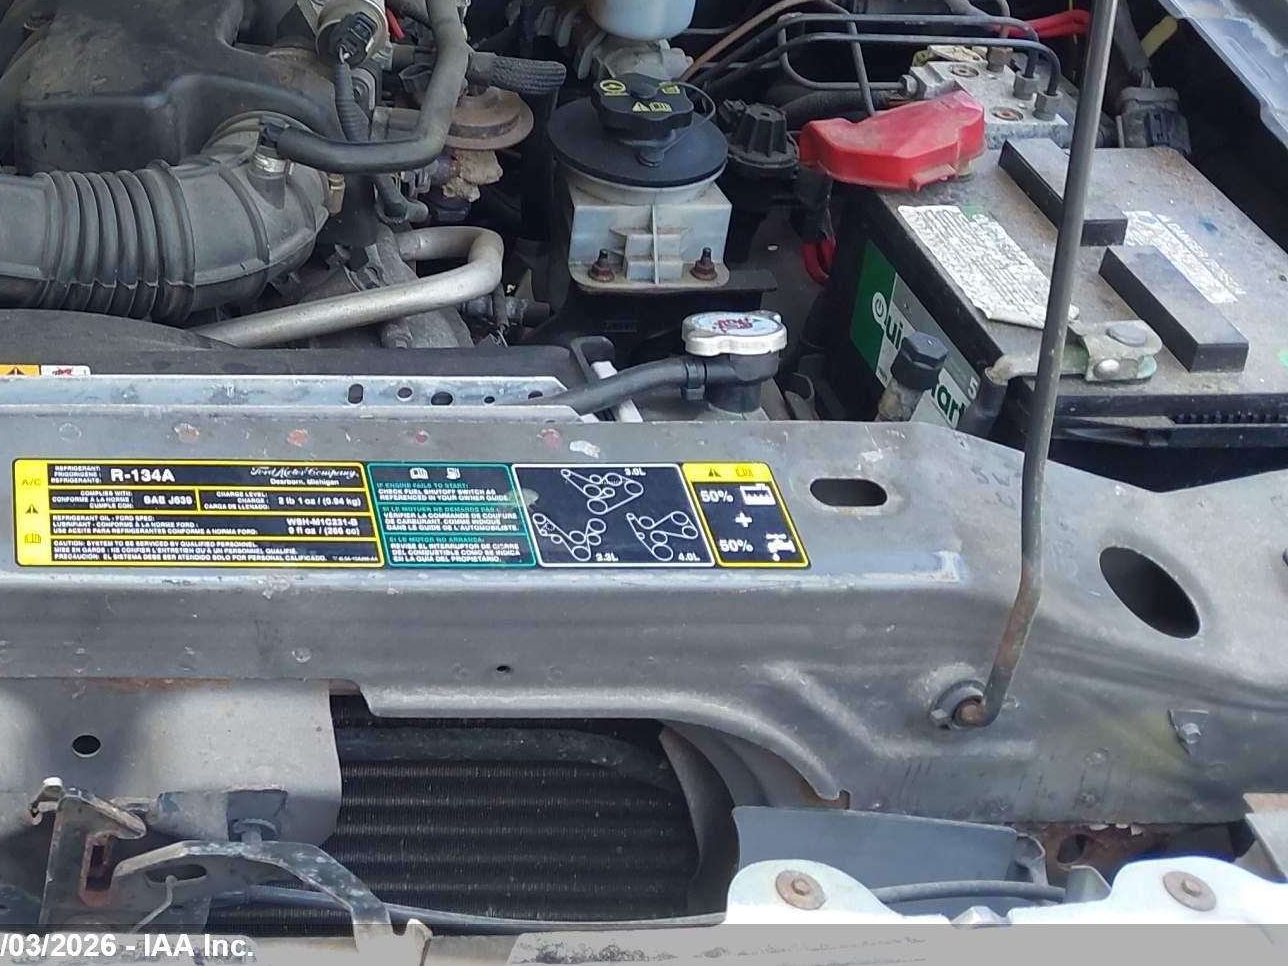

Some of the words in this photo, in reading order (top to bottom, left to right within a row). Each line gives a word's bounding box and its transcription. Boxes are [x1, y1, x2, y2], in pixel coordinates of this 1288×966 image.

[110, 468, 176, 484] R-134A
[624, 467, 646, 476] 3.0L
[22, 478, 41, 486] A/C
[700, 489, 733, 503] 50%
[719, 539, 753, 553] 50%
[678, 553, 700, 562] 4.0L
